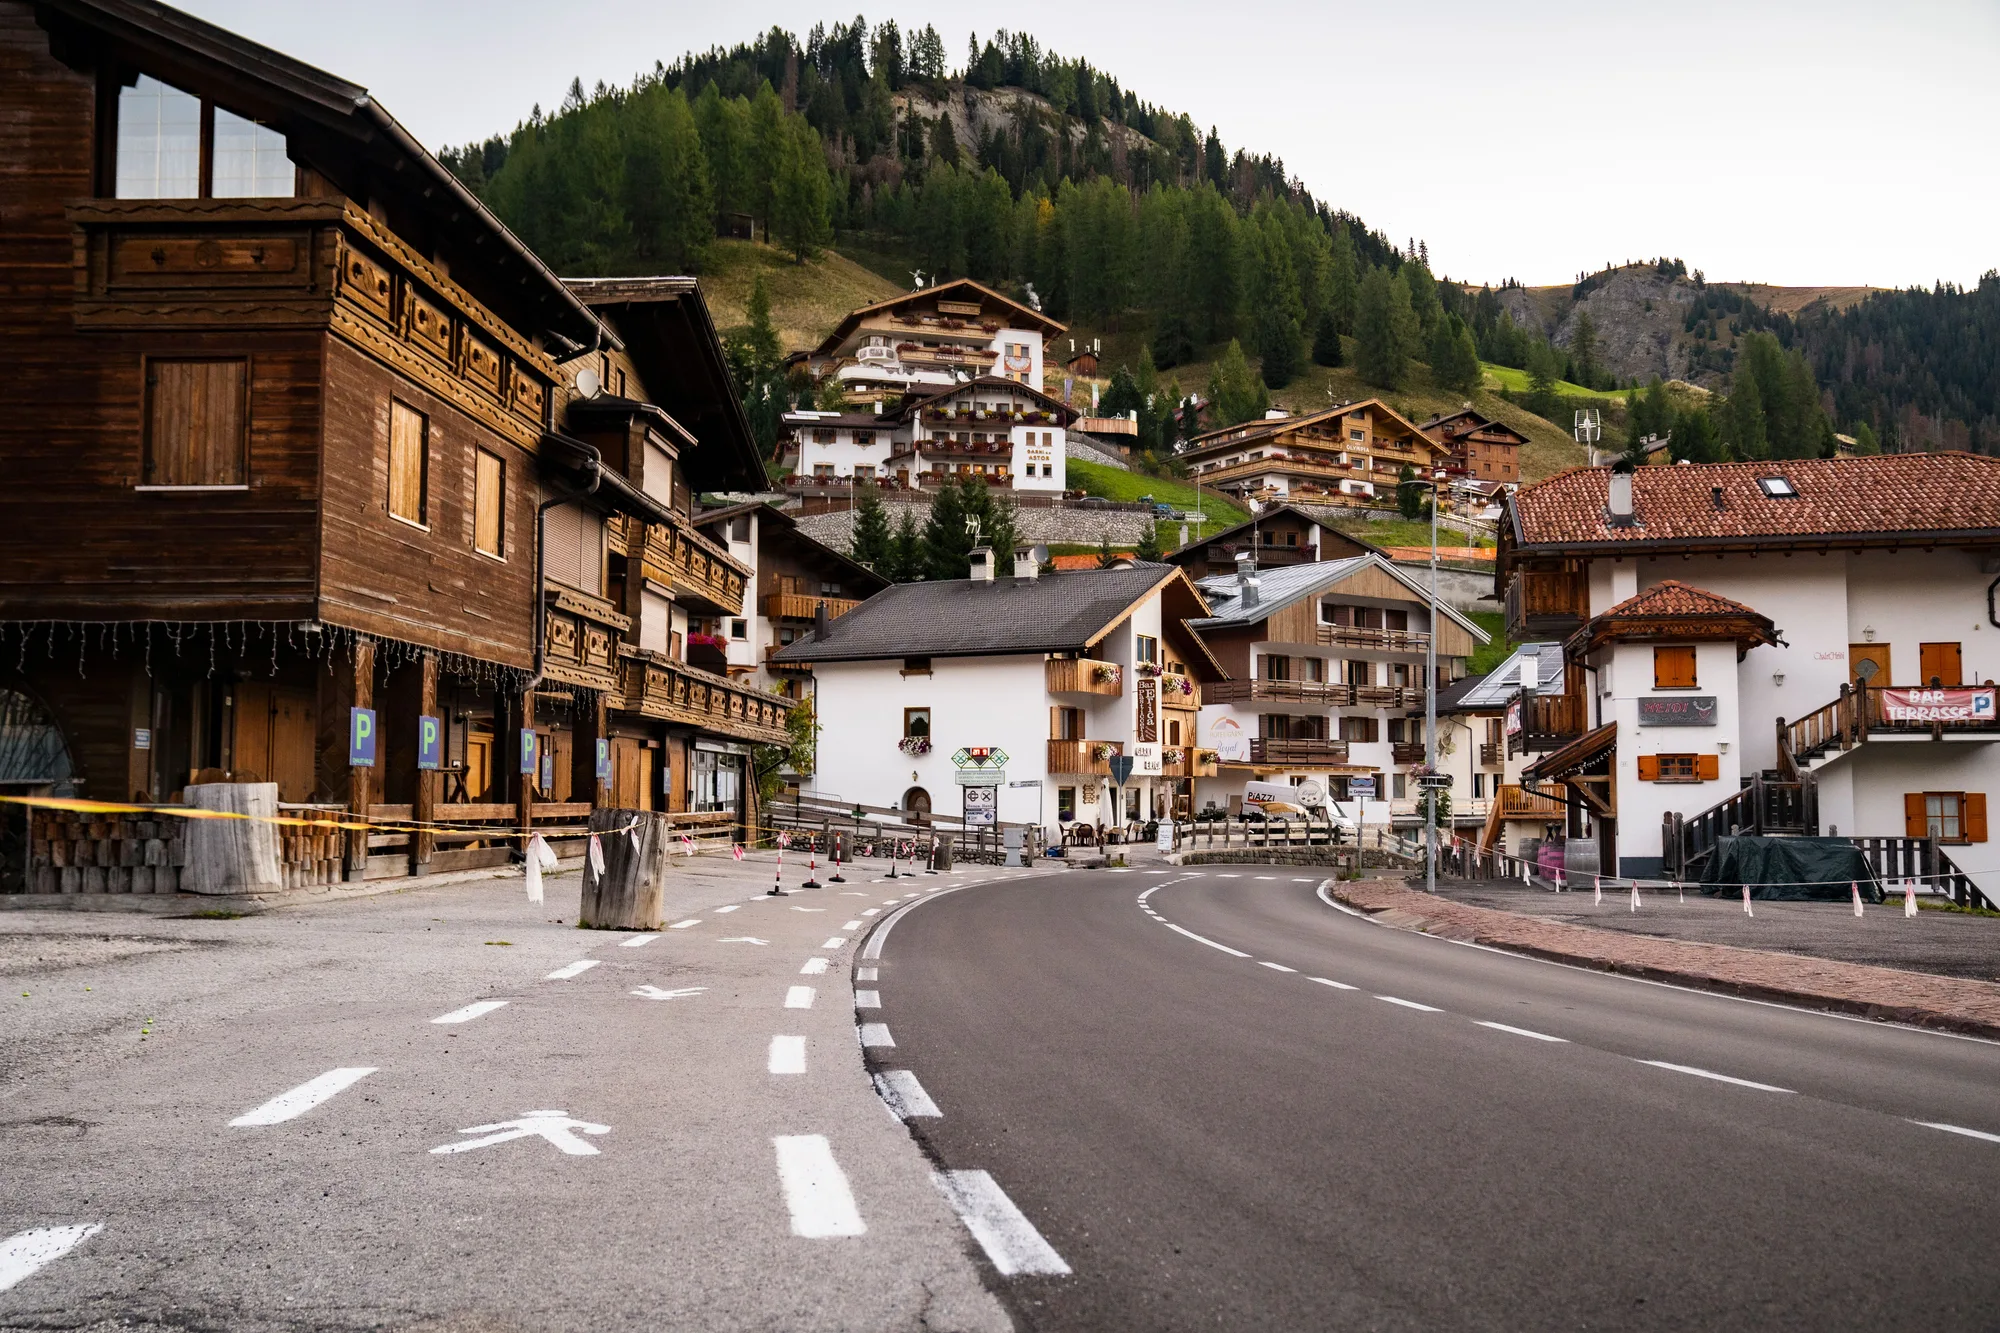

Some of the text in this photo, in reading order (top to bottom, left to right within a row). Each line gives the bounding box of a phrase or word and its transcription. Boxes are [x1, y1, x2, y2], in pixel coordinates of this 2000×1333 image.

[1346, 444, 1370, 453] OLYMPIA
[1138, 681, 1155, 689] Bar
[1909, 690, 1945, 704] BAR
[1974, 696, 1990, 713] P
[1146, 689, 1155, 725] Erica
[1644, 702, 1689, 713] HEIDI
[1886, 706, 1969, 720] TERRASSE
[356, 713, 371, 750] P
[423, 721, 436, 755] P
[524, 733, 534, 762] P
[599, 742, 606, 767] P
[1217, 740, 1238, 757] Royal
[545, 757, 551, 775] P
